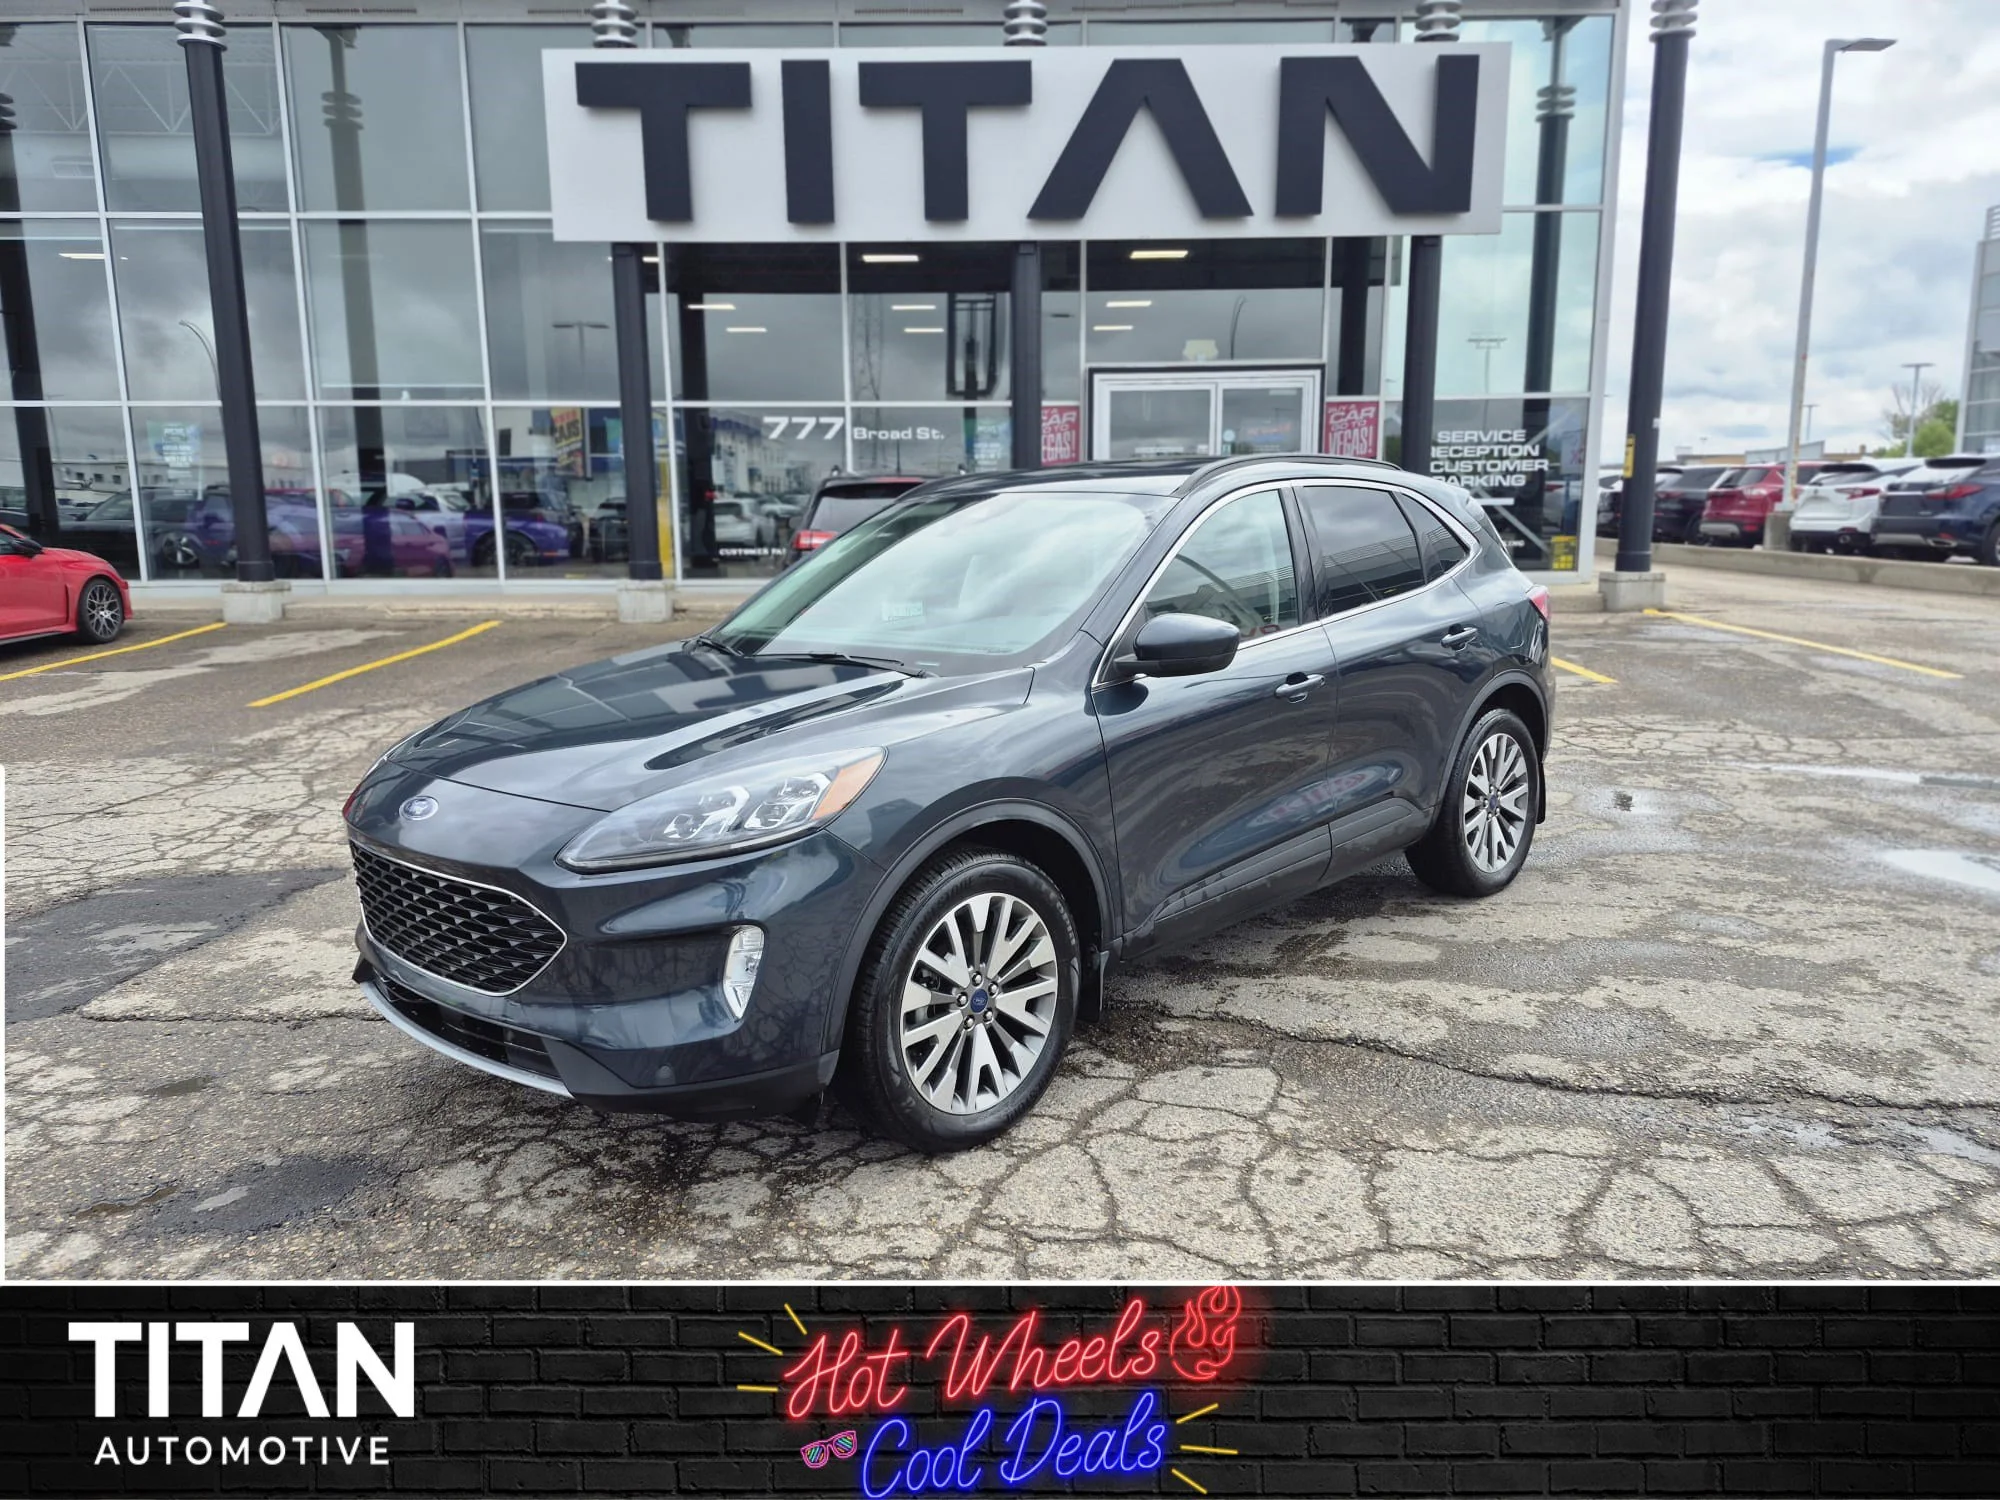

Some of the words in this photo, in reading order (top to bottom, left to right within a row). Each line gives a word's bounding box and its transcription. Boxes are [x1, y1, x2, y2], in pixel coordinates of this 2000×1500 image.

[575, 54, 1480, 224] TITAN
[1330, 406, 1376, 424] CAR
[763, 416, 844, 440] 777
[853, 427, 912, 440] Broad
[916, 427, 945, 440] St.
[1437, 429, 1526, 443] SERVICE
[1041, 430, 1076, 463] EGAS!
[1330, 426, 1373, 456] VEGAS!
[1430, 459, 1549, 473] CUSTOMER
